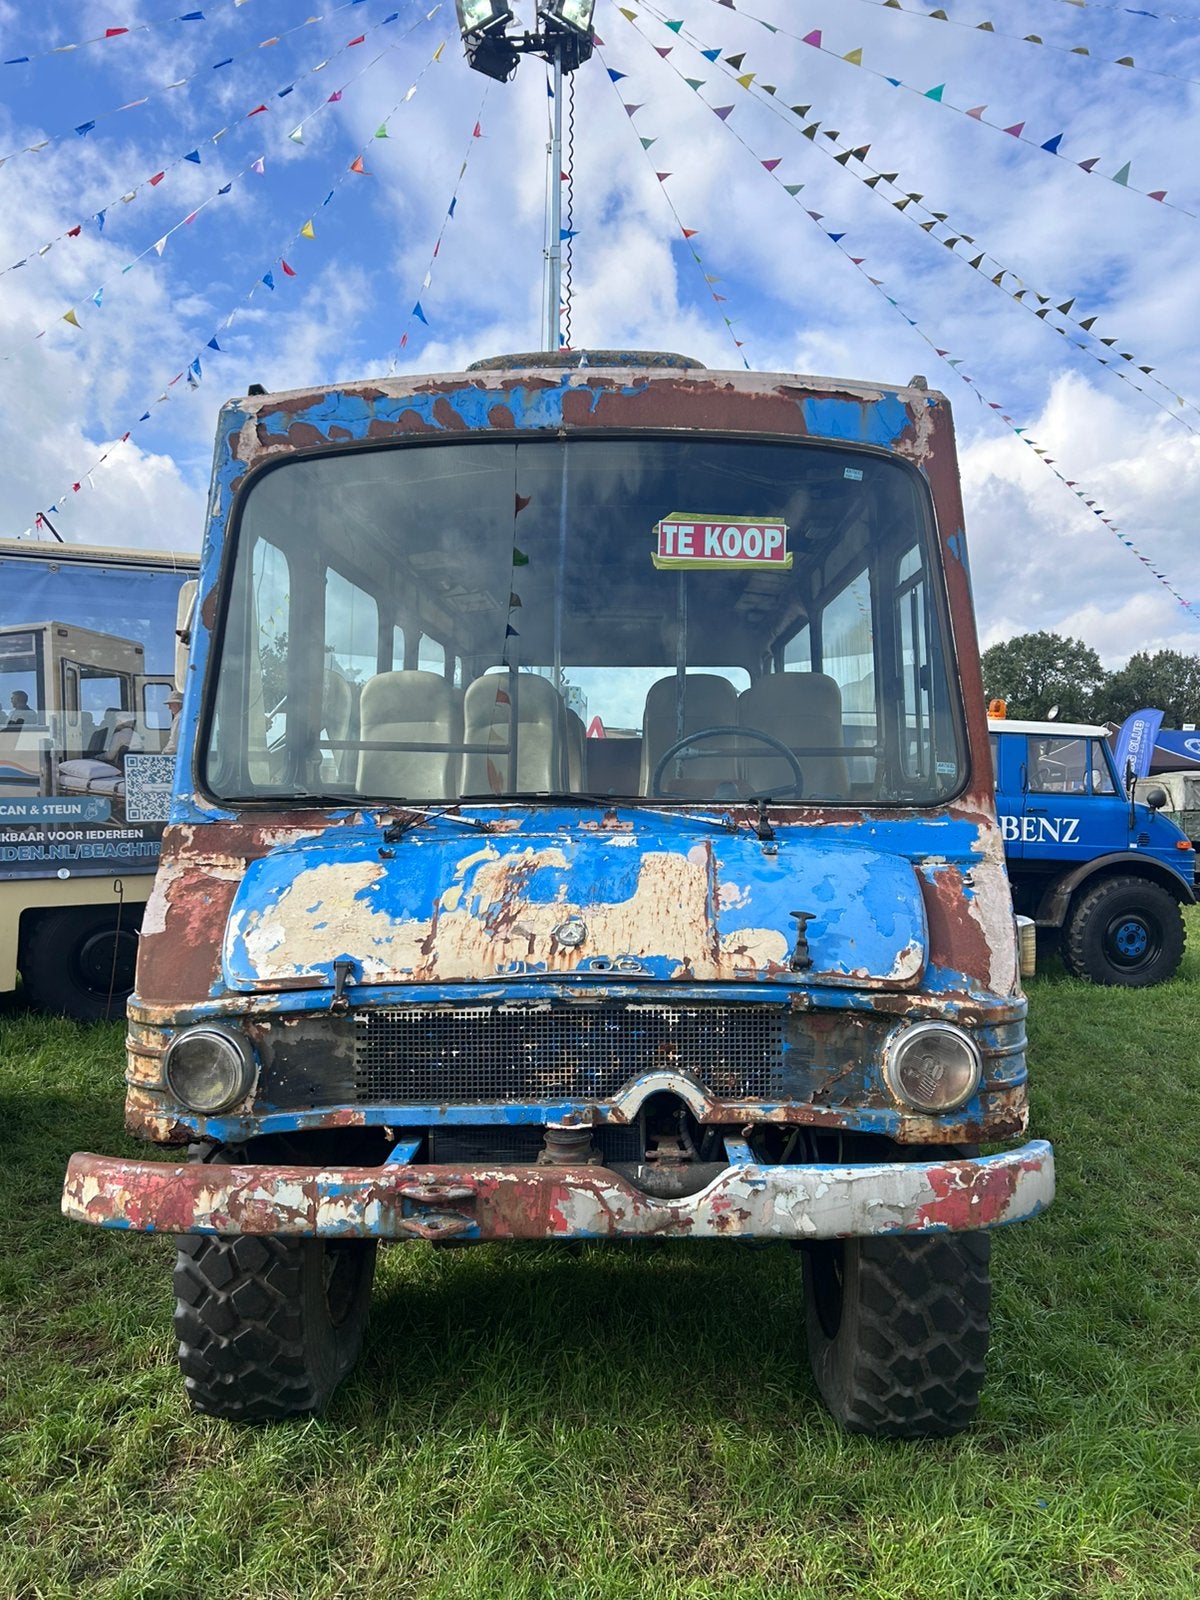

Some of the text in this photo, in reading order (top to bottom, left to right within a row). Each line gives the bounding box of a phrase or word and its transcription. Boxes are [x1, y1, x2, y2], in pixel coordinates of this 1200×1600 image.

[662, 525, 782, 558] TE KOOP
[1129, 720, 1144, 752] CLUB
[0, 804, 81, 815] CAN & STEUN
[48, 831, 83, 841] VOOR
[86, 829, 144, 840] IEDEREEN
[999, 816, 1080, 843] BENZ
